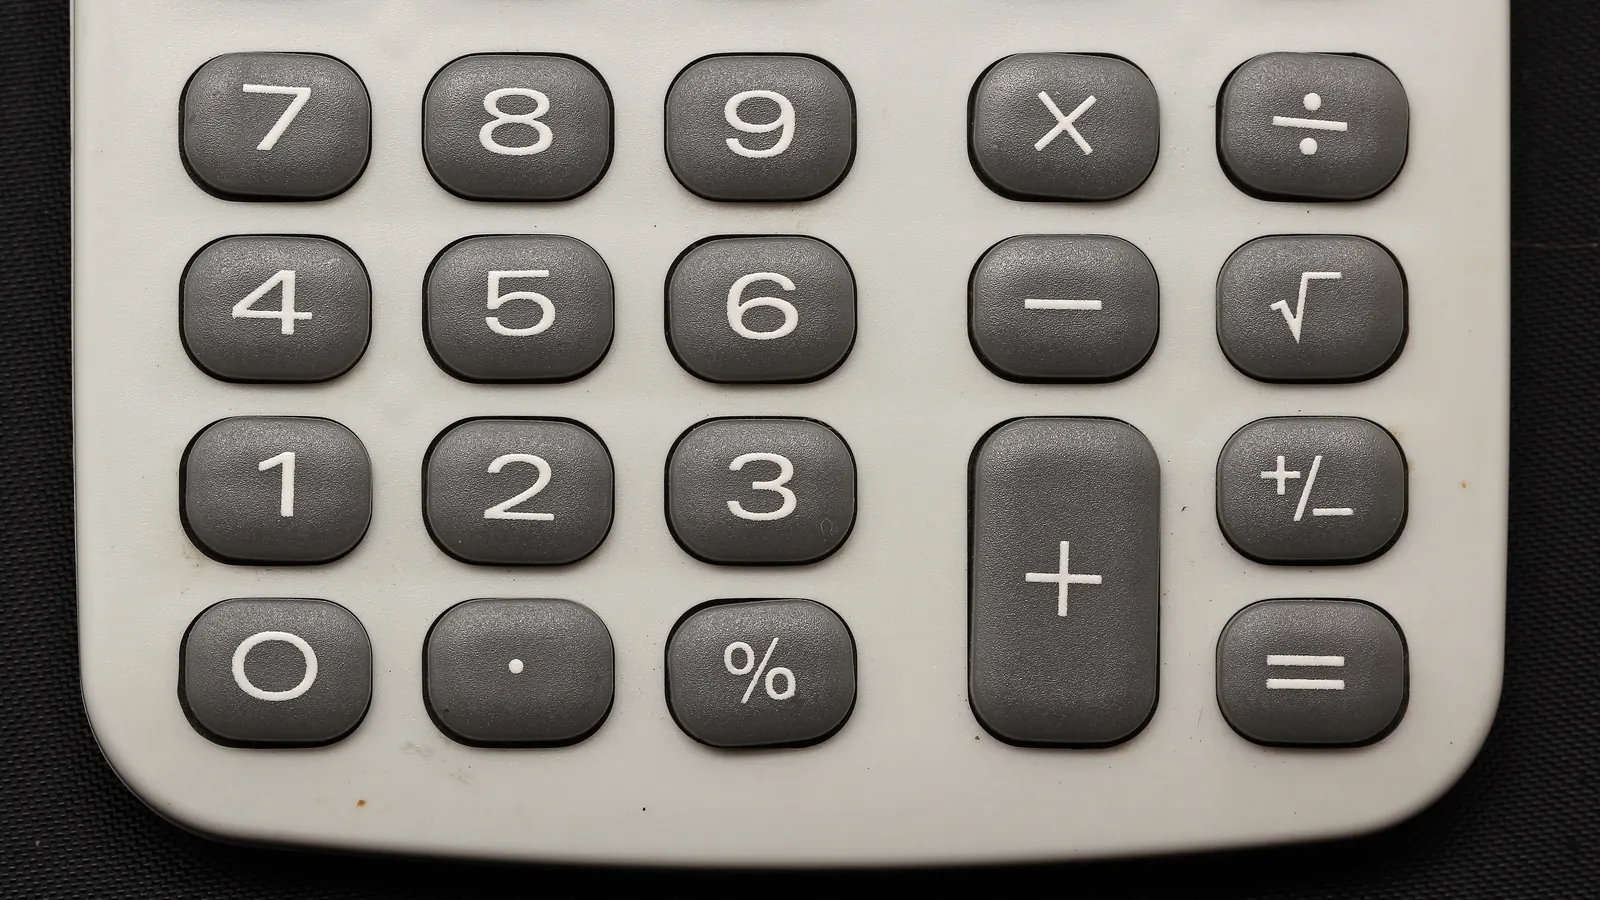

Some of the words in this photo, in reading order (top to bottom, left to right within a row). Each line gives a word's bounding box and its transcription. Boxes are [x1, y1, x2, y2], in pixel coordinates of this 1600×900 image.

[242, 84, 312, 152] 7
[478, 87, 554, 157] 8
[724, 90, 796, 159] 9
[231, 269, 313, 336] 4
[485, 269, 556, 338] 5
[726, 272, 799, 340] 6
[258, 452, 296, 518] 1
[484, 453, 556, 521] 2
[726, 453, 797, 522] 3
[232, 631, 319, 702] 0
[724, 637, 797, 704] %
